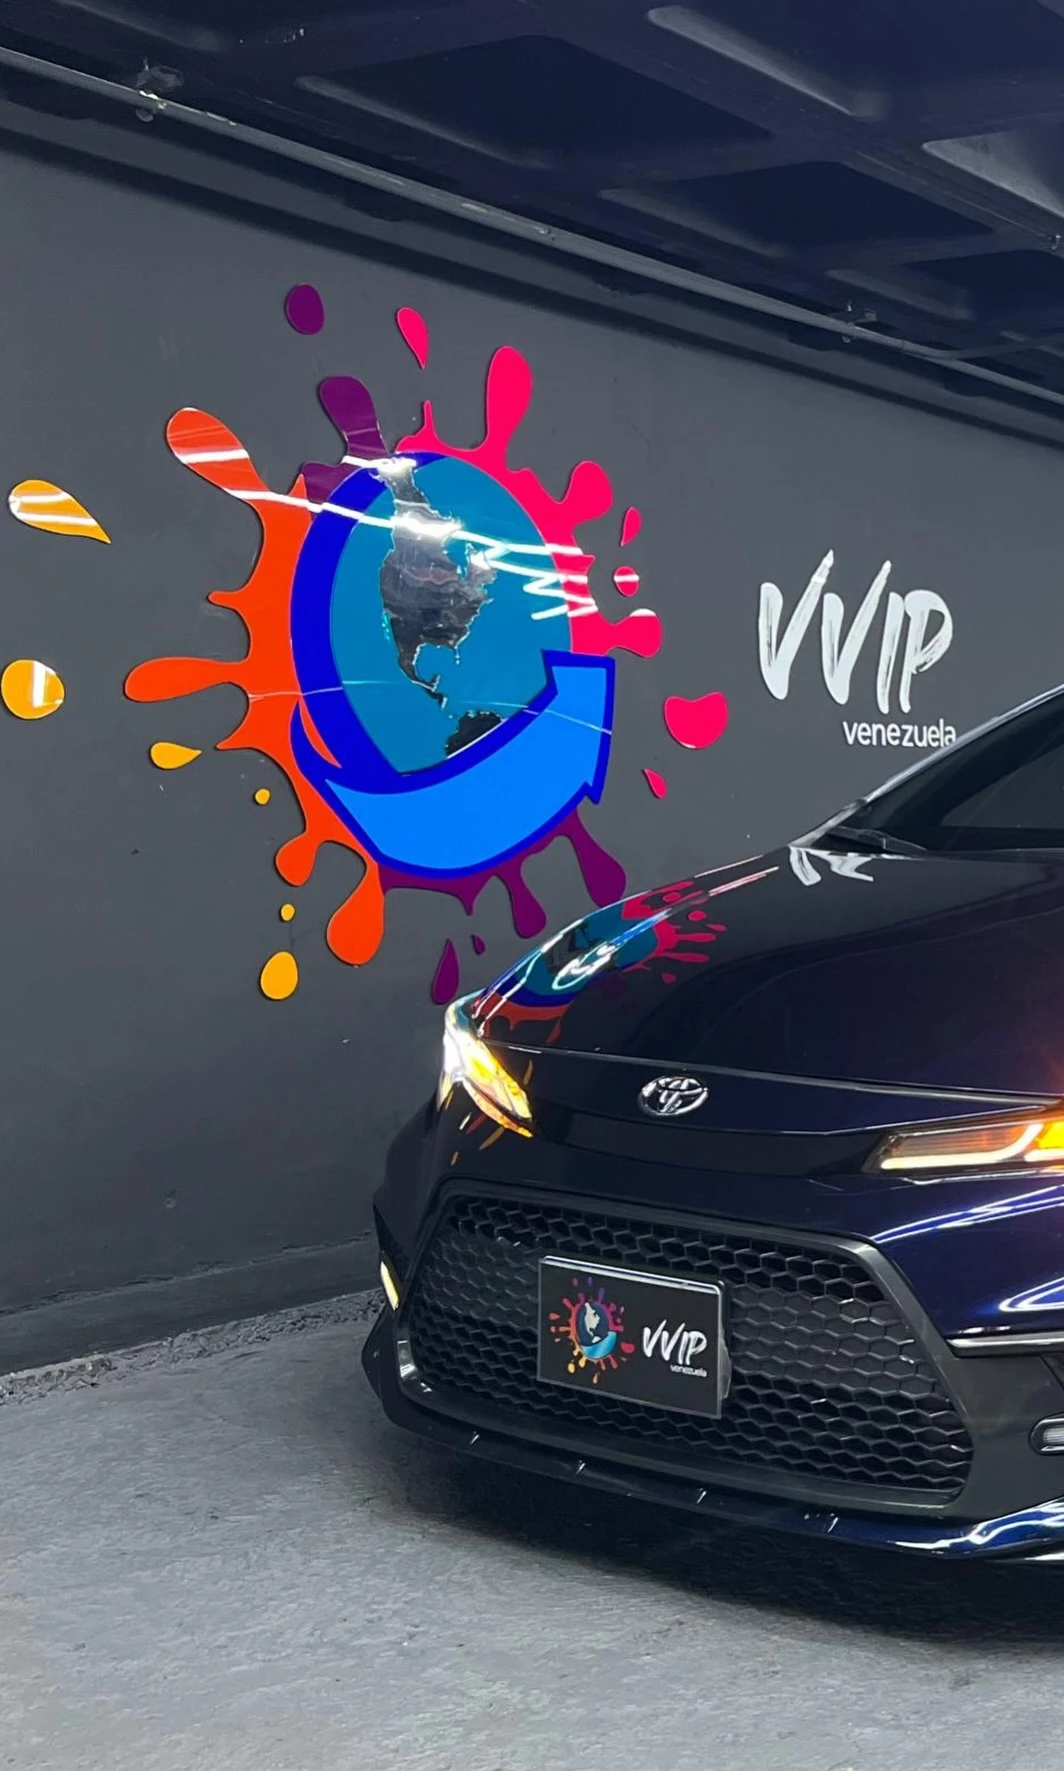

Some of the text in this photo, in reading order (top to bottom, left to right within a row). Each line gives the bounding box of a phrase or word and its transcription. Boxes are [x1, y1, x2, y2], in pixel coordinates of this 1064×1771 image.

[758, 549, 953, 713] VVIP
[843, 718, 957, 747] venezuela
[643, 1319, 708, 1366] VVIP
[670, 1364, 708, 1378] venezuela
